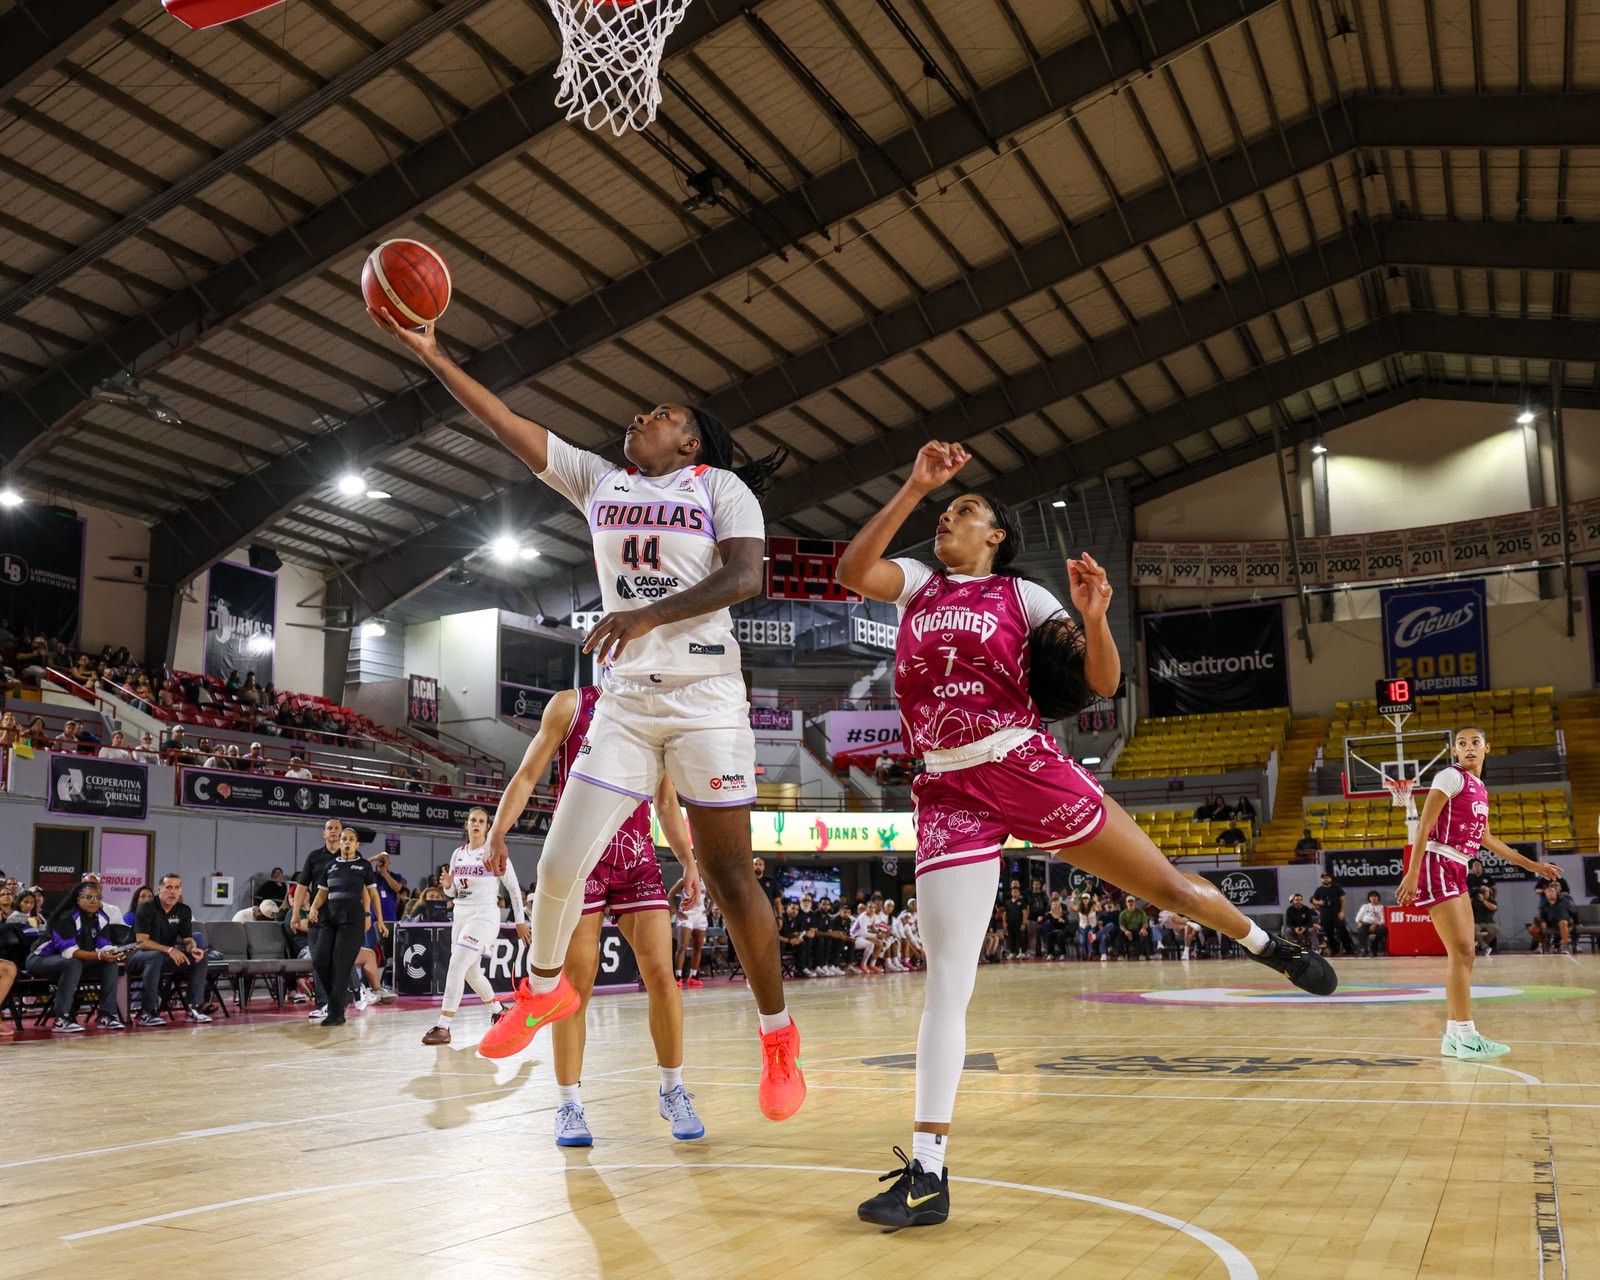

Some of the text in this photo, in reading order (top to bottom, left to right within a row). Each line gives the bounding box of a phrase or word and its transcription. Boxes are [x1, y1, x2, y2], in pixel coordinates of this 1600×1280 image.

[597, 504, 705, 532] CRIOLLAS
[1541, 529, 1577, 547] 206
[621, 535, 661, 572] 44
[1454, 544, 1489, 560] 2014
[1496, 537, 1532, 555] 2015
[1368, 554, 1403, 570] 2005
[1412, 550, 1444, 565] 2011
[1136, 564, 1162, 577] 1996
[1173, 565, 1200, 577] 1997
[1210, 564, 1238, 577] 1998
[1246, 563, 1280, 577] 2000
[1327, 559, 1361, 573] 2002
[634, 576, 679, 587] CAGUAS
[636, 587, 667, 597] COOP
[911, 608, 998, 644] GIGANTES
[1395, 602, 1474, 648] CAGUAS
[938, 646, 958, 677] 7
[1158, 649, 1274, 677] Medtronic
[1396, 652, 1477, 679] 2006
[933, 681, 985, 698] GOYA
[1415, 675, 1478, 690] MPEONES
[1389, 681, 1409, 702] 18
[1380, 704, 1413, 713] CITIZEN
[848, 728, 902, 743] #SOM
[85, 776, 141, 789] COOPERATIVA
[104, 791, 141, 805] ORIENTAL
[268, 799, 290, 808] ICHIBAN
[367, 801, 387, 811] CELSIUS
[391, 800, 420, 813] Chobani
[1060, 796, 1090, 821] FUERTE
[1040, 803, 1070, 826] MENTE
[1065, 804, 1097, 830] FUERTE
[39, 865, 74, 874] CAMERINO
[1333, 863, 1389, 877] Medina
[100, 876, 142, 886] CRIOLLOS
[1221, 877, 1250, 892] Pasta
[1405, 914, 1432, 923] TRIPL
[1060, 1054, 1424, 1067] CAGUAS
[1035, 1063, 1301, 1074] COOP
